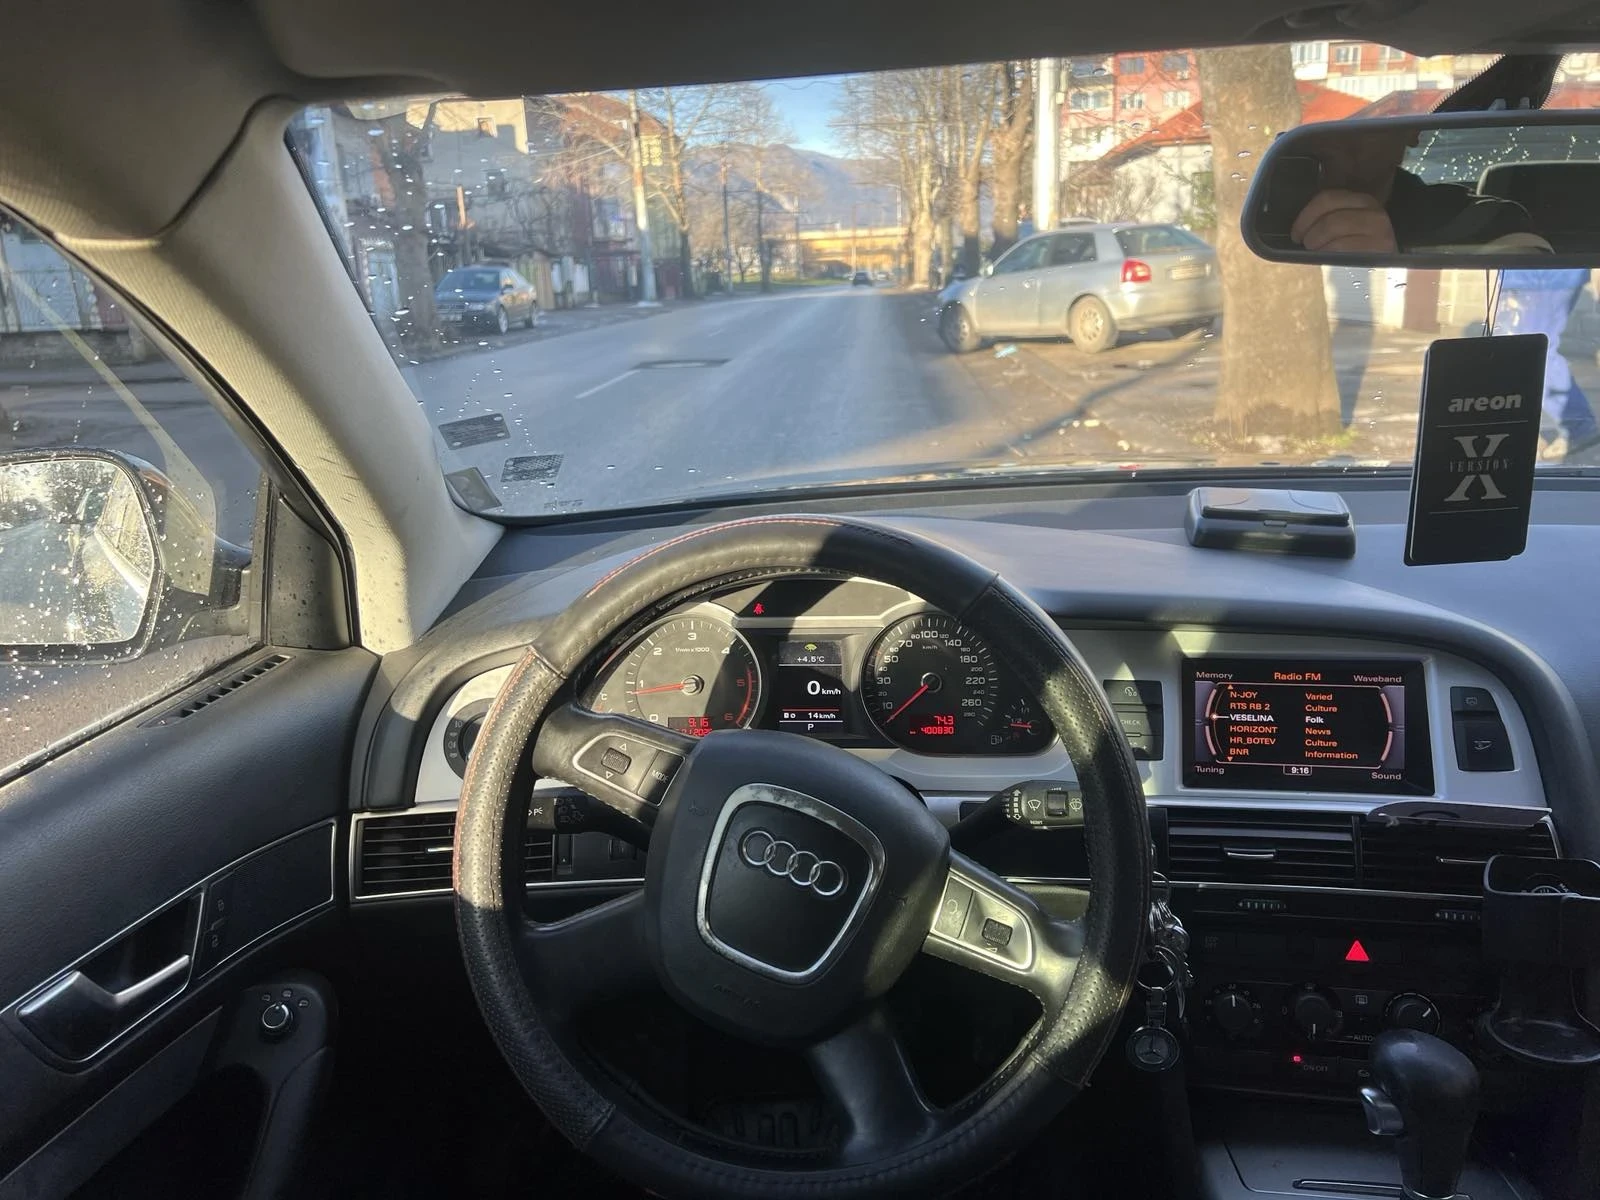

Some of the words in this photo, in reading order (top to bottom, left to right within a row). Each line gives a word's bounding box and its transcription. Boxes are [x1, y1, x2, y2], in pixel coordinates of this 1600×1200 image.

[1448, 394, 1522, 412] areon
[1450, 458, 1510, 473] VERSION
[688, 632, 697, 640] 3
[898, 640, 913, 648] 70
[653, 647, 663, 655] 2
[884, 655, 899, 663] 50
[960, 655, 978, 663] 180
[1196, 671, 1233, 680] Memory
[1274, 672, 1302, 680] Radio
[1305, 673, 1321, 681] FM
[1353, 675, 1402, 683] Waveband
[877, 677, 891, 685] 30
[965, 677, 985, 685] 220
[807, 680, 820, 695] 0
[1230, 691, 1258, 699] N-JOY
[883, 701, 893, 710] 10
[961, 699, 982, 707] 260
[1265, 703, 1271, 711] 2
[1305, 704, 1338, 713] Culture
[688, 717, 708, 727] 9:16
[1229, 714, 1274, 722] VESELINA
[1305, 716, 1324, 724] Folk
[807, 723, 815, 731] P
[921, 726, 954, 735] 400830
[1230, 725, 1278, 733] HORIZONT
[1305, 727, 1331, 735] News
[1229, 737, 1276, 745] HR_BOTEV
[1305, 739, 1338, 747] Culture
[1229, 748, 1249, 756] BNR
[1305, 751, 1358, 759] Information
[1195, 765, 1225, 774] Tuning
[1371, 772, 1402, 780] Sound
